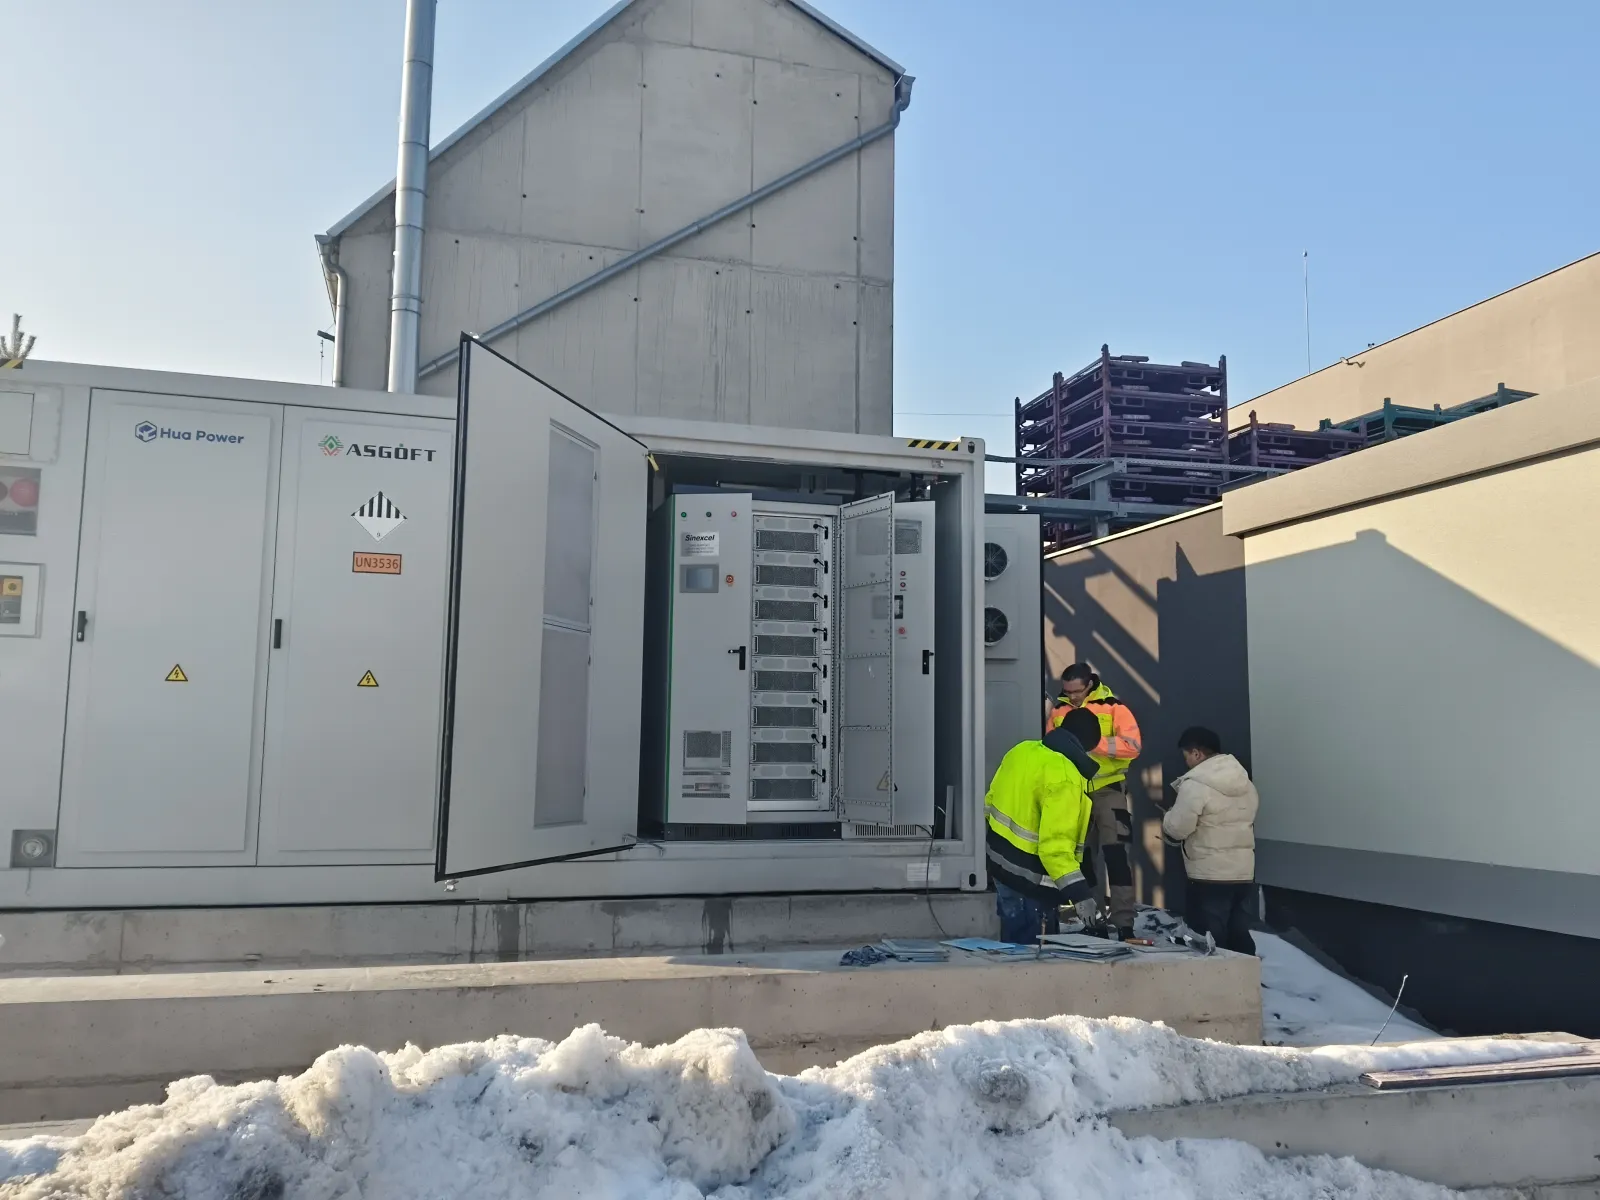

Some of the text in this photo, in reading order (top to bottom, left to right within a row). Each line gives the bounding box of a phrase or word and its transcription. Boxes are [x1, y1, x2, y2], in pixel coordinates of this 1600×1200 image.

[160, 428, 244, 443] Hua Power
[685, 534, 715, 542] Sinexcel
[355, 556, 399, 570] UN3536
